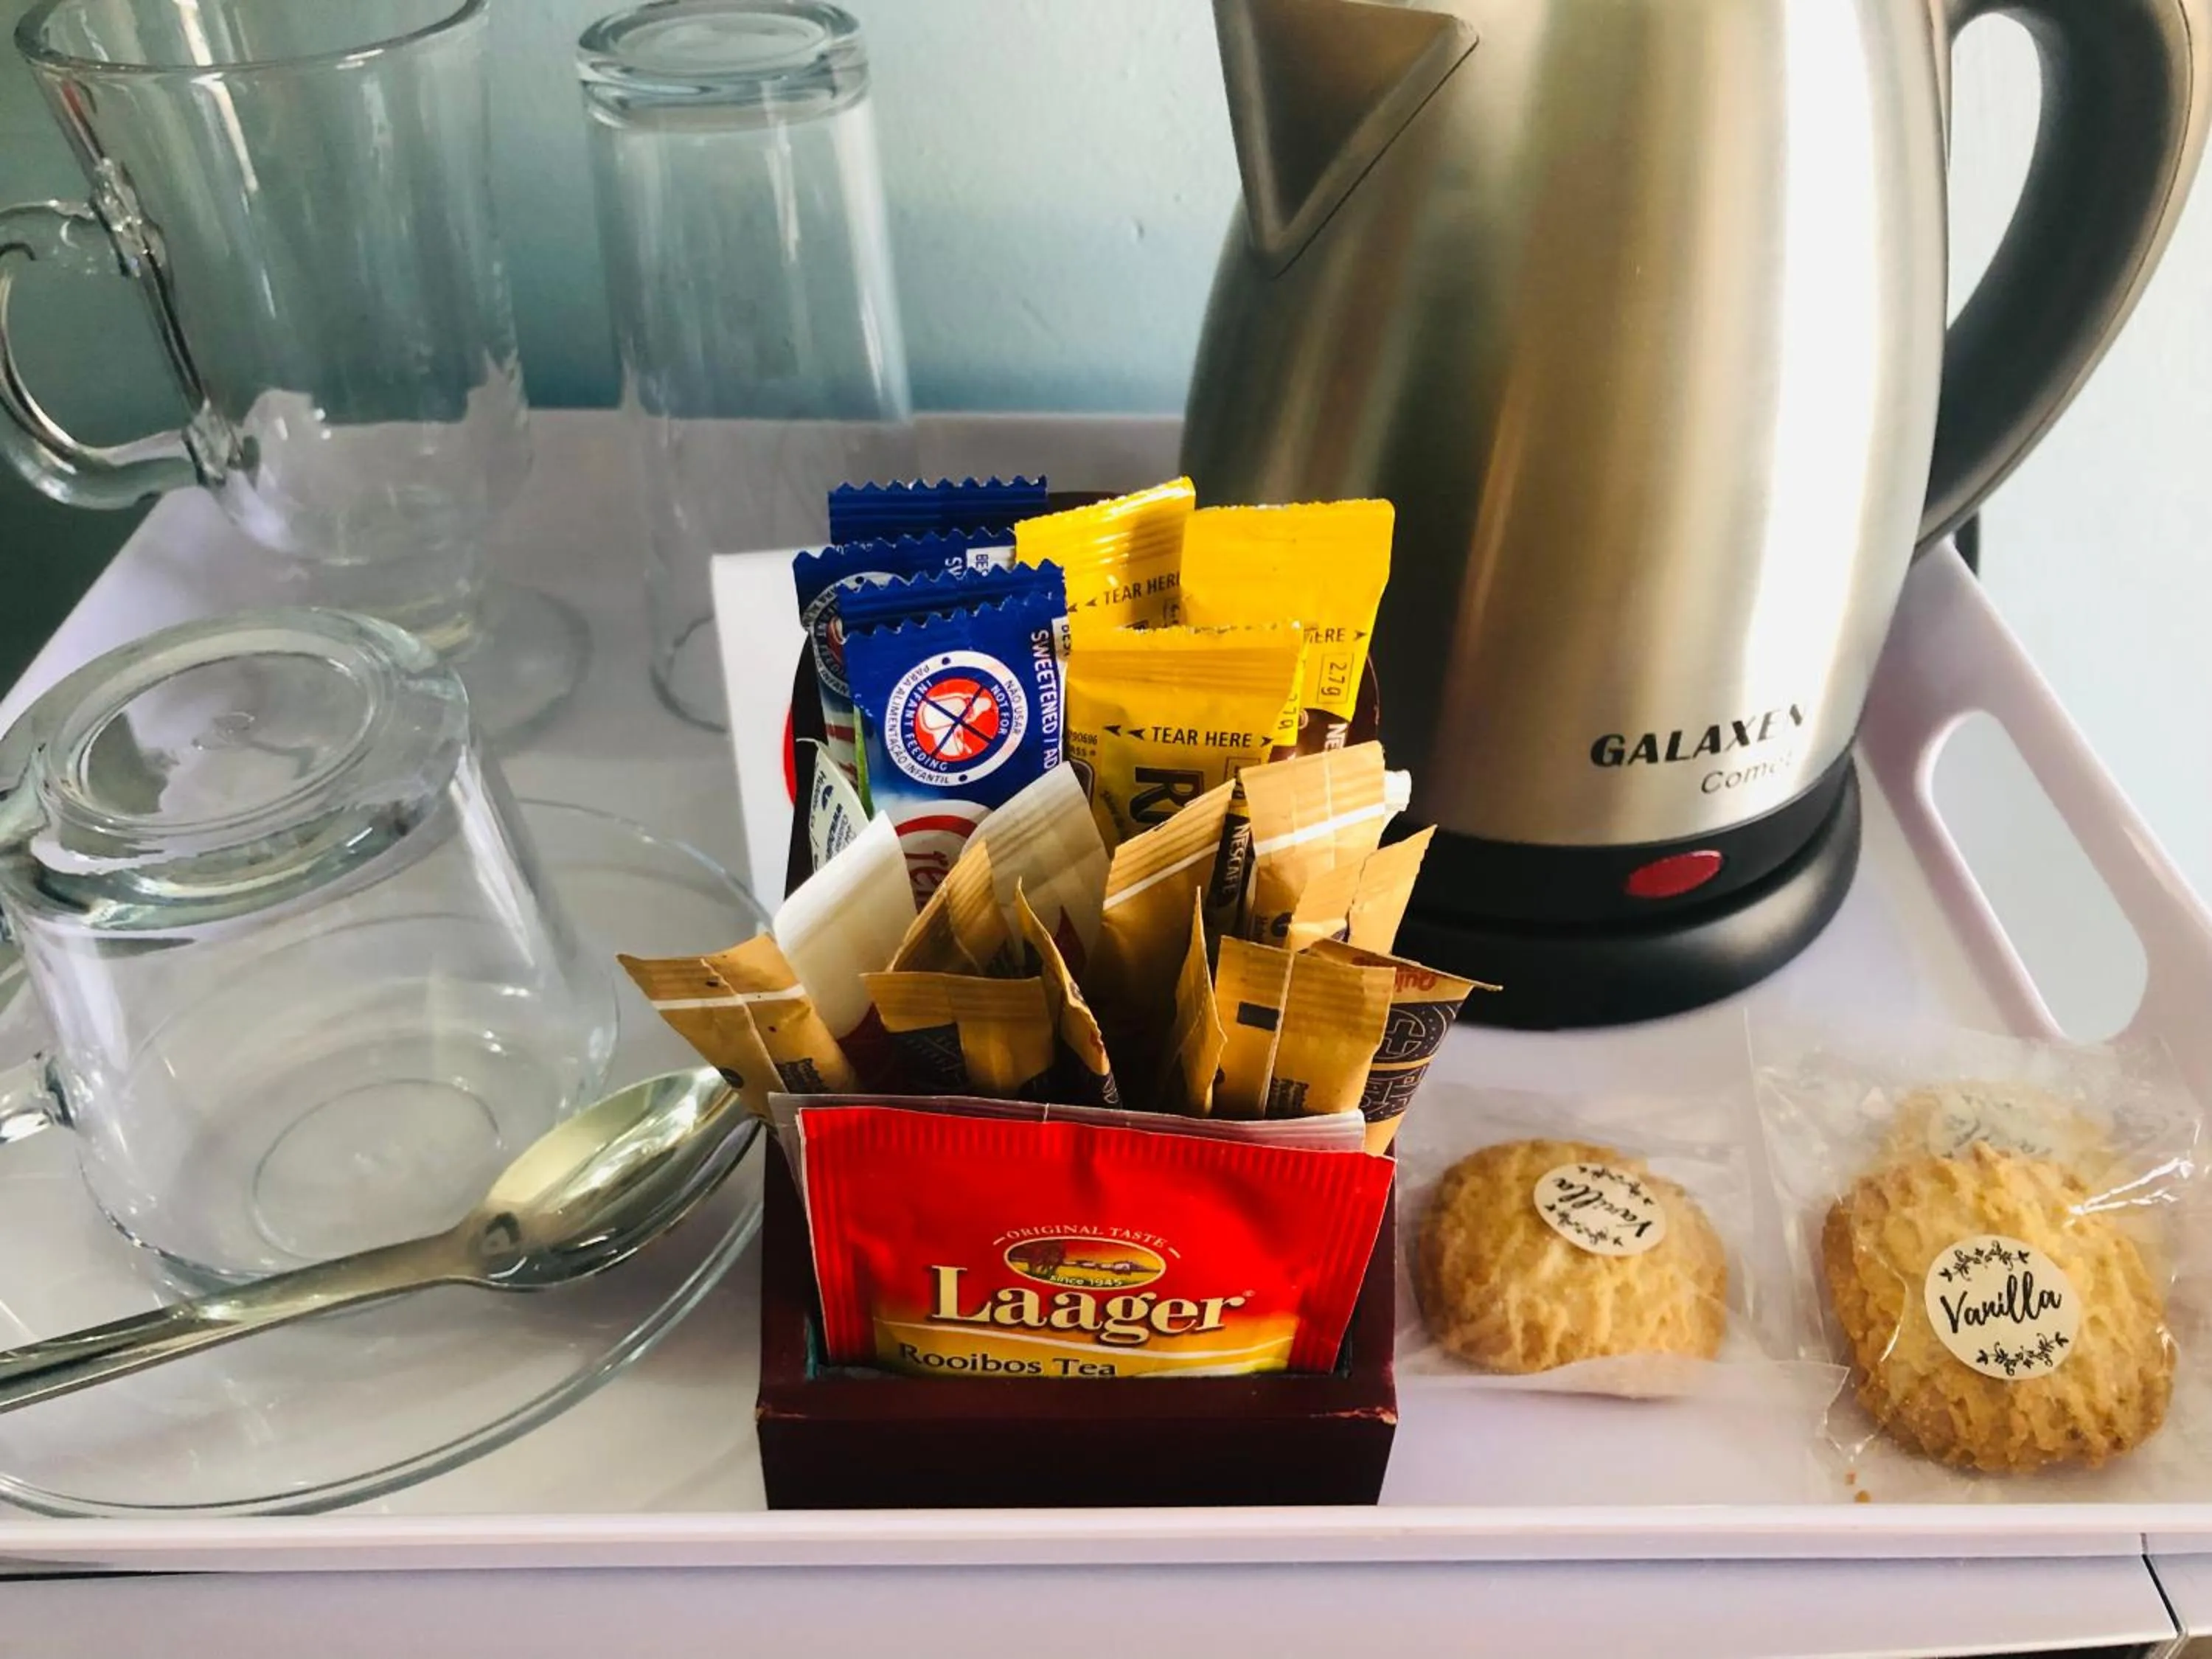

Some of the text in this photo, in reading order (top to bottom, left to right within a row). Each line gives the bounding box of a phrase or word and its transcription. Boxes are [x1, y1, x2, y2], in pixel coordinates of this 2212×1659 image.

[1104, 583, 1142, 605] TEAR
[903, 664, 930, 689] PARA
[1030, 630, 1058, 736] SWEETENED
[902, 680, 949, 773] INFANT FEEDING
[990, 684, 1010, 737] NOT FOR
[1151, 726, 1253, 748] TEAR HERE
[906, 761, 950, 785] INFANTIL
[1552, 1177, 1654, 1239] Vanilla
[1006, 1224, 1169, 1248] ORIGINAL TASTE
[930, 1264, 1246, 1346] Laager
[1938, 1270, 2064, 1335] Vanilla
[898, 1342, 1116, 1377] Rooibos Tea
